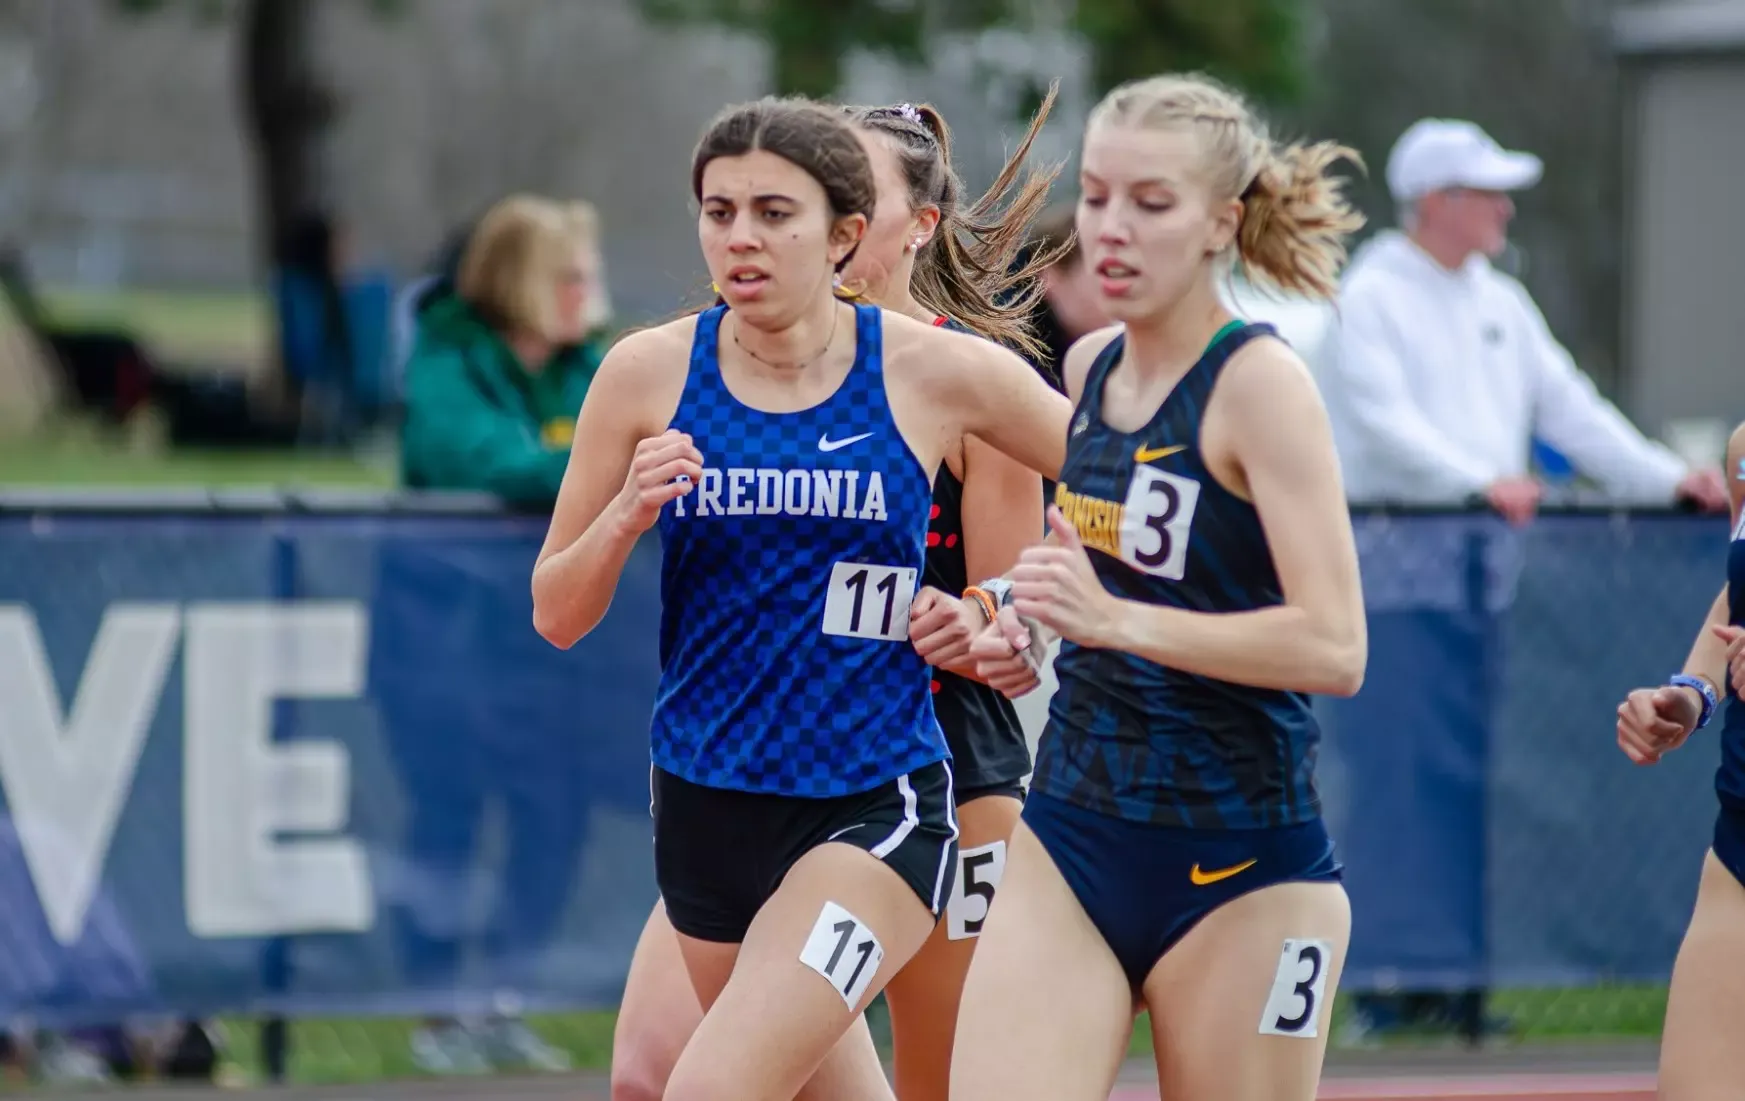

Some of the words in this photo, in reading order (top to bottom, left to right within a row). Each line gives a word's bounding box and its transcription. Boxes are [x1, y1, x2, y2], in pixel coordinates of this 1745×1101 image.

[675, 468, 888, 521] FREDONIA
[1134, 480, 1180, 567] 3
[844, 569, 898, 636] 11
[0, 602, 376, 946] VE
[963, 851, 996, 933] 5
[824, 919, 876, 996] 11
[1275, 946, 1322, 1033] 3
